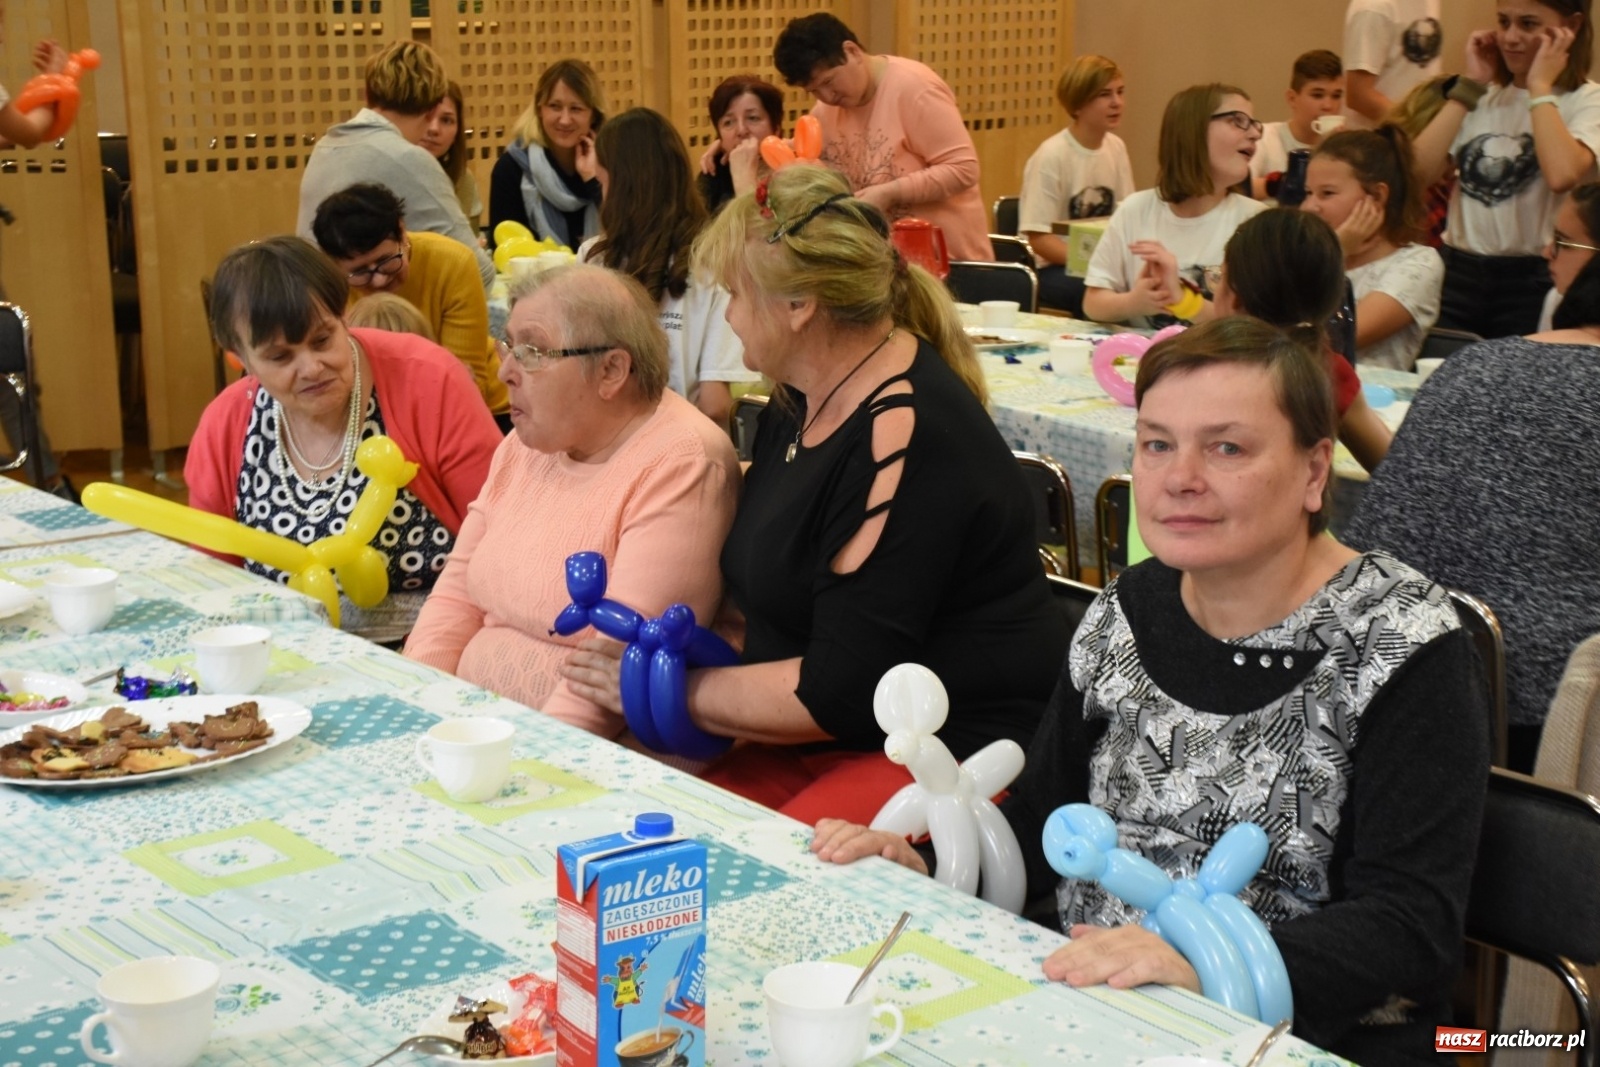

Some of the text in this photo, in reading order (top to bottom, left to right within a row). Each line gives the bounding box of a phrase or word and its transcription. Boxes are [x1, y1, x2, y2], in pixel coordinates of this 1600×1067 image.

[602, 862, 702, 908] mleko
[605, 892, 700, 926] ZAGĘSZCZONE
[606, 909, 700, 943] NIESŁODZONE
